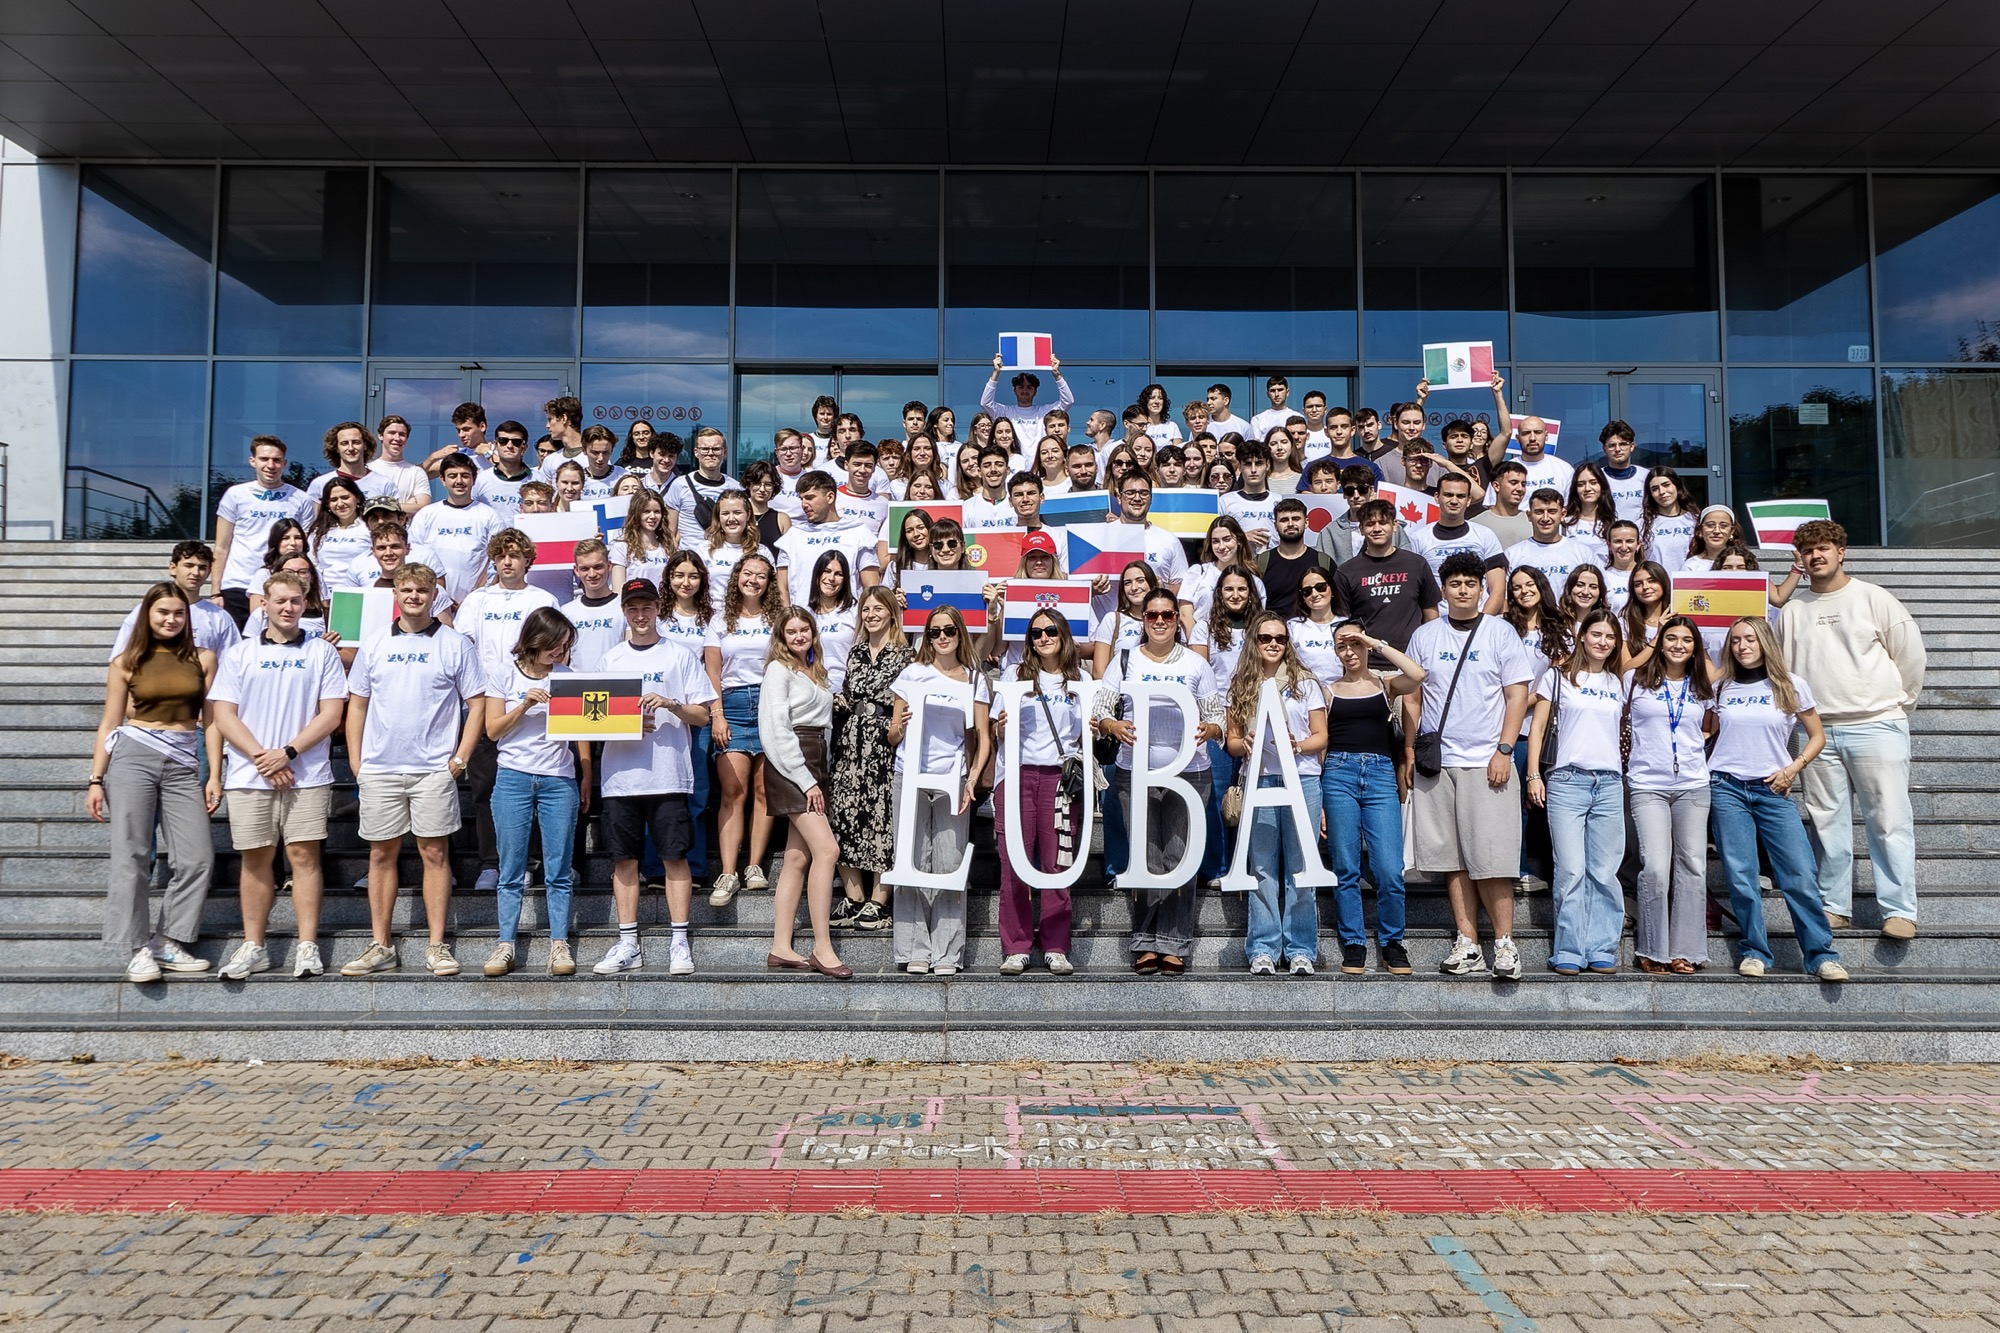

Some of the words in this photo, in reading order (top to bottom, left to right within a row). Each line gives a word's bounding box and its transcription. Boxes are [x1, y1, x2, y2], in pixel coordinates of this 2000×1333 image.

[1361, 572, 1408, 586] BUCKEYE
[1370, 585, 1401, 596] STATE
[880, 677, 1338, 892] EUBA
